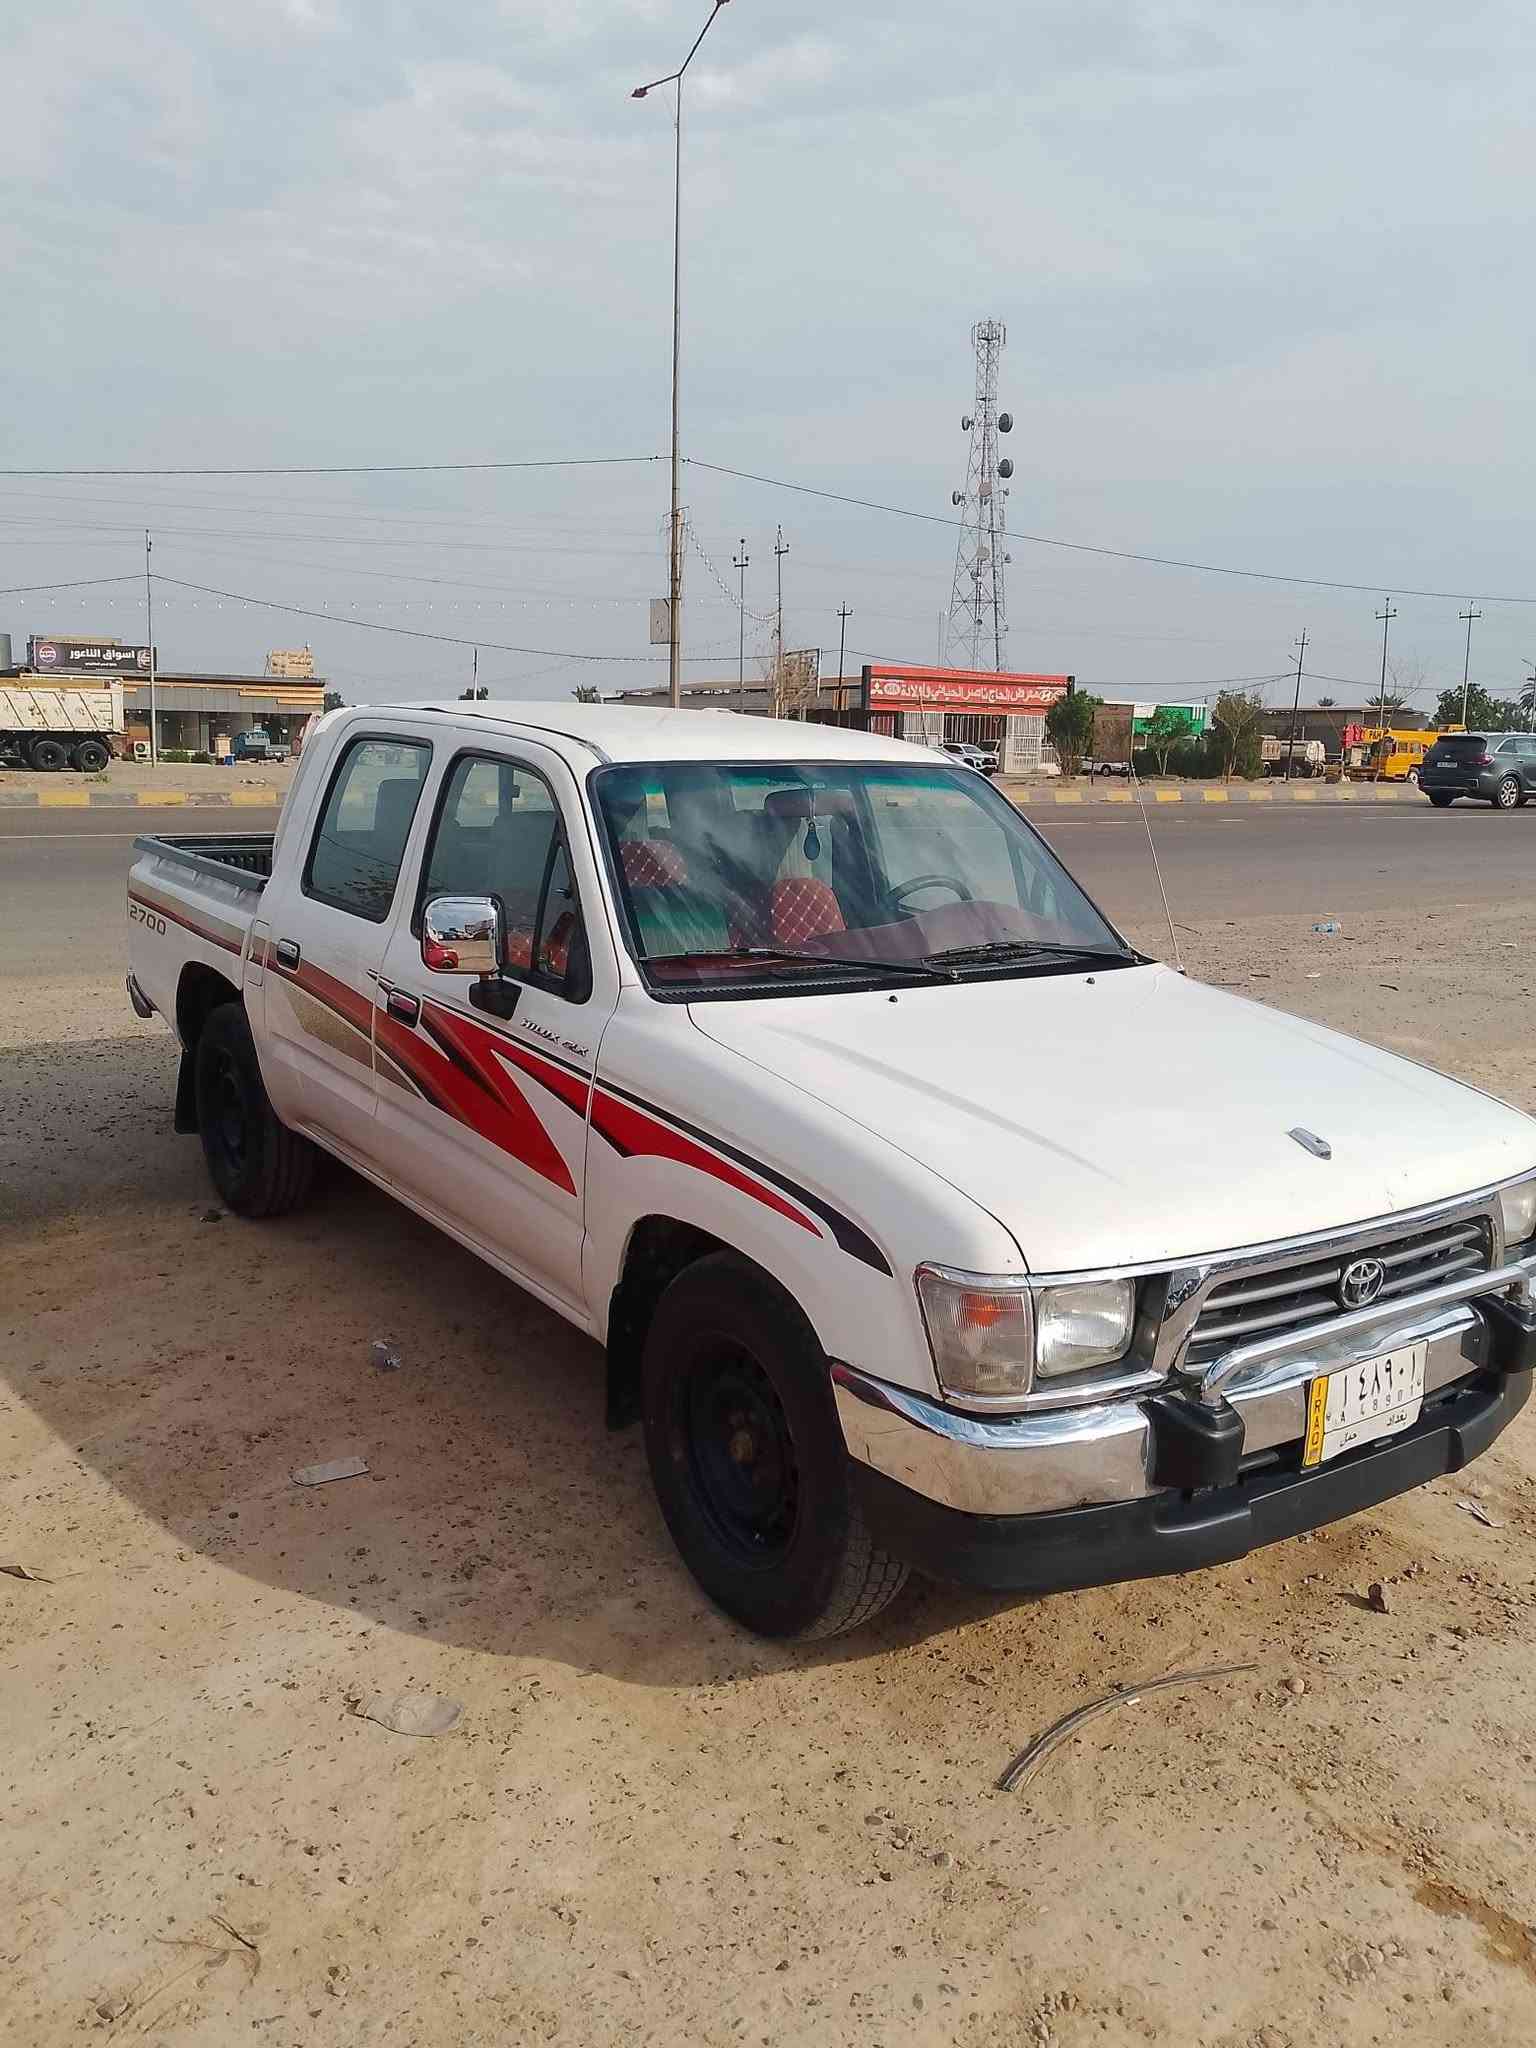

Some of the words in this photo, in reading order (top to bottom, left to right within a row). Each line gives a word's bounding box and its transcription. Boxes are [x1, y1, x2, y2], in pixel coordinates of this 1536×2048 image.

[102, 650, 135, 660] اسواق
[989, 687, 1010, 703] الحاج
[1011, 687, 1040, 702] معرض
[130, 904, 166, 935] 2700
[1311, 1383, 1321, 1445] IRAQ
